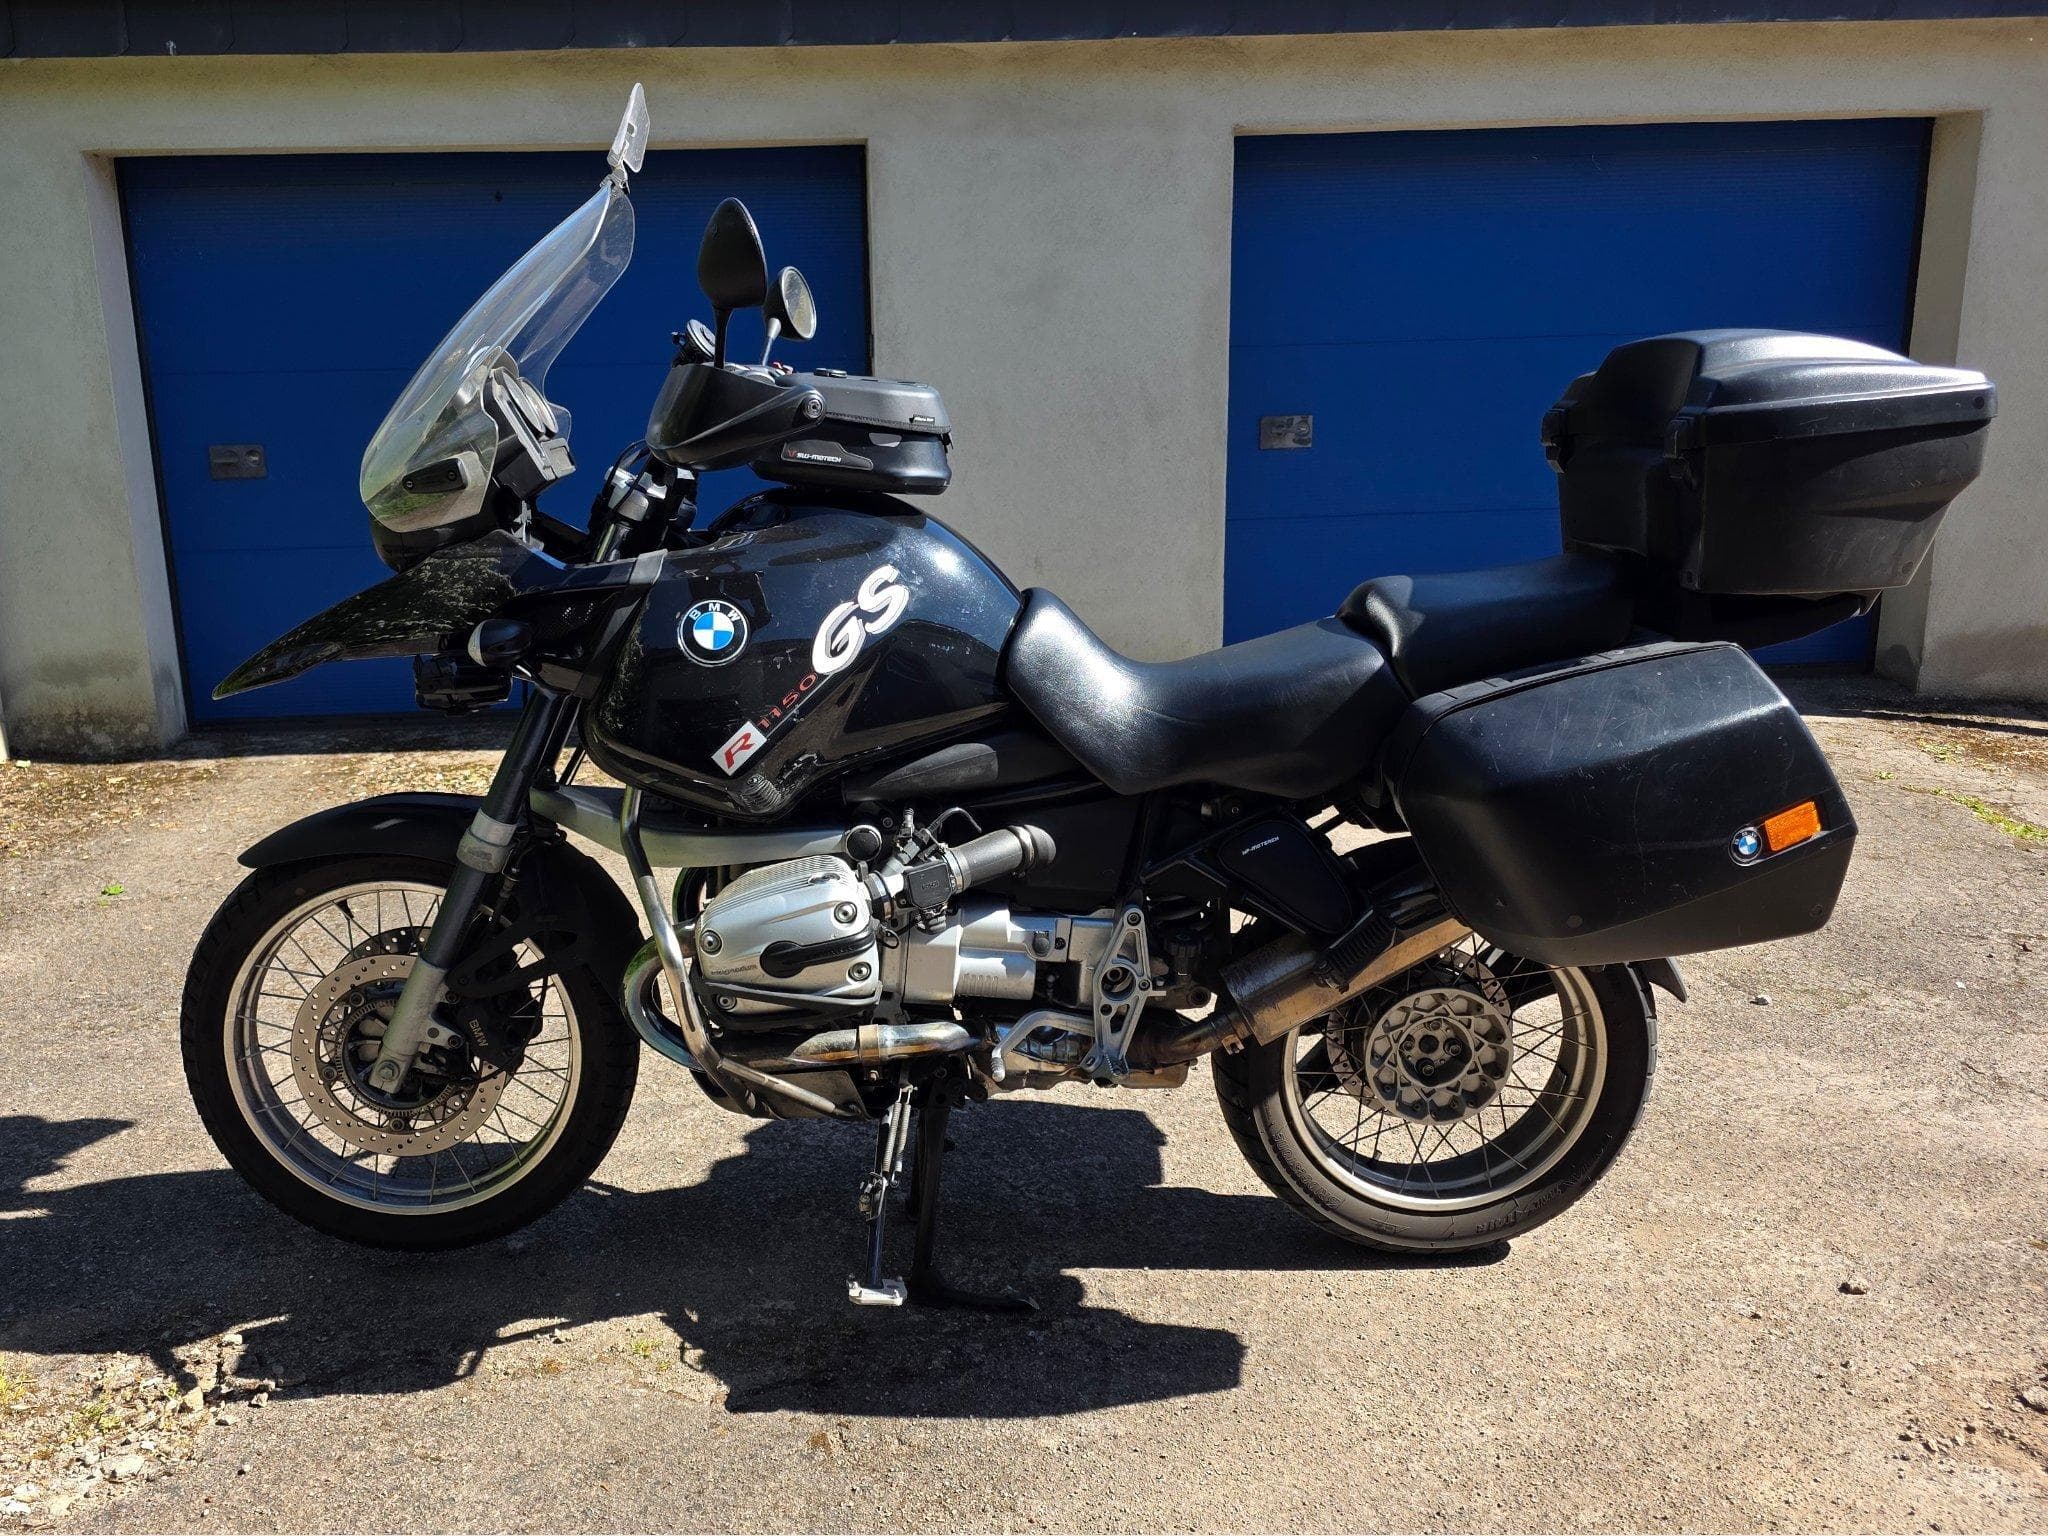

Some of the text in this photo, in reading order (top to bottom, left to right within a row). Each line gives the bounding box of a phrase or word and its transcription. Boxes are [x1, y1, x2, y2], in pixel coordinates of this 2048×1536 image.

[797, 452, 842, 462] SW-MOTECH
[689, 602, 741, 622] BMW
[724, 564, 910, 769] R 1150 GS
[469, 1019, 489, 1047] BMW
